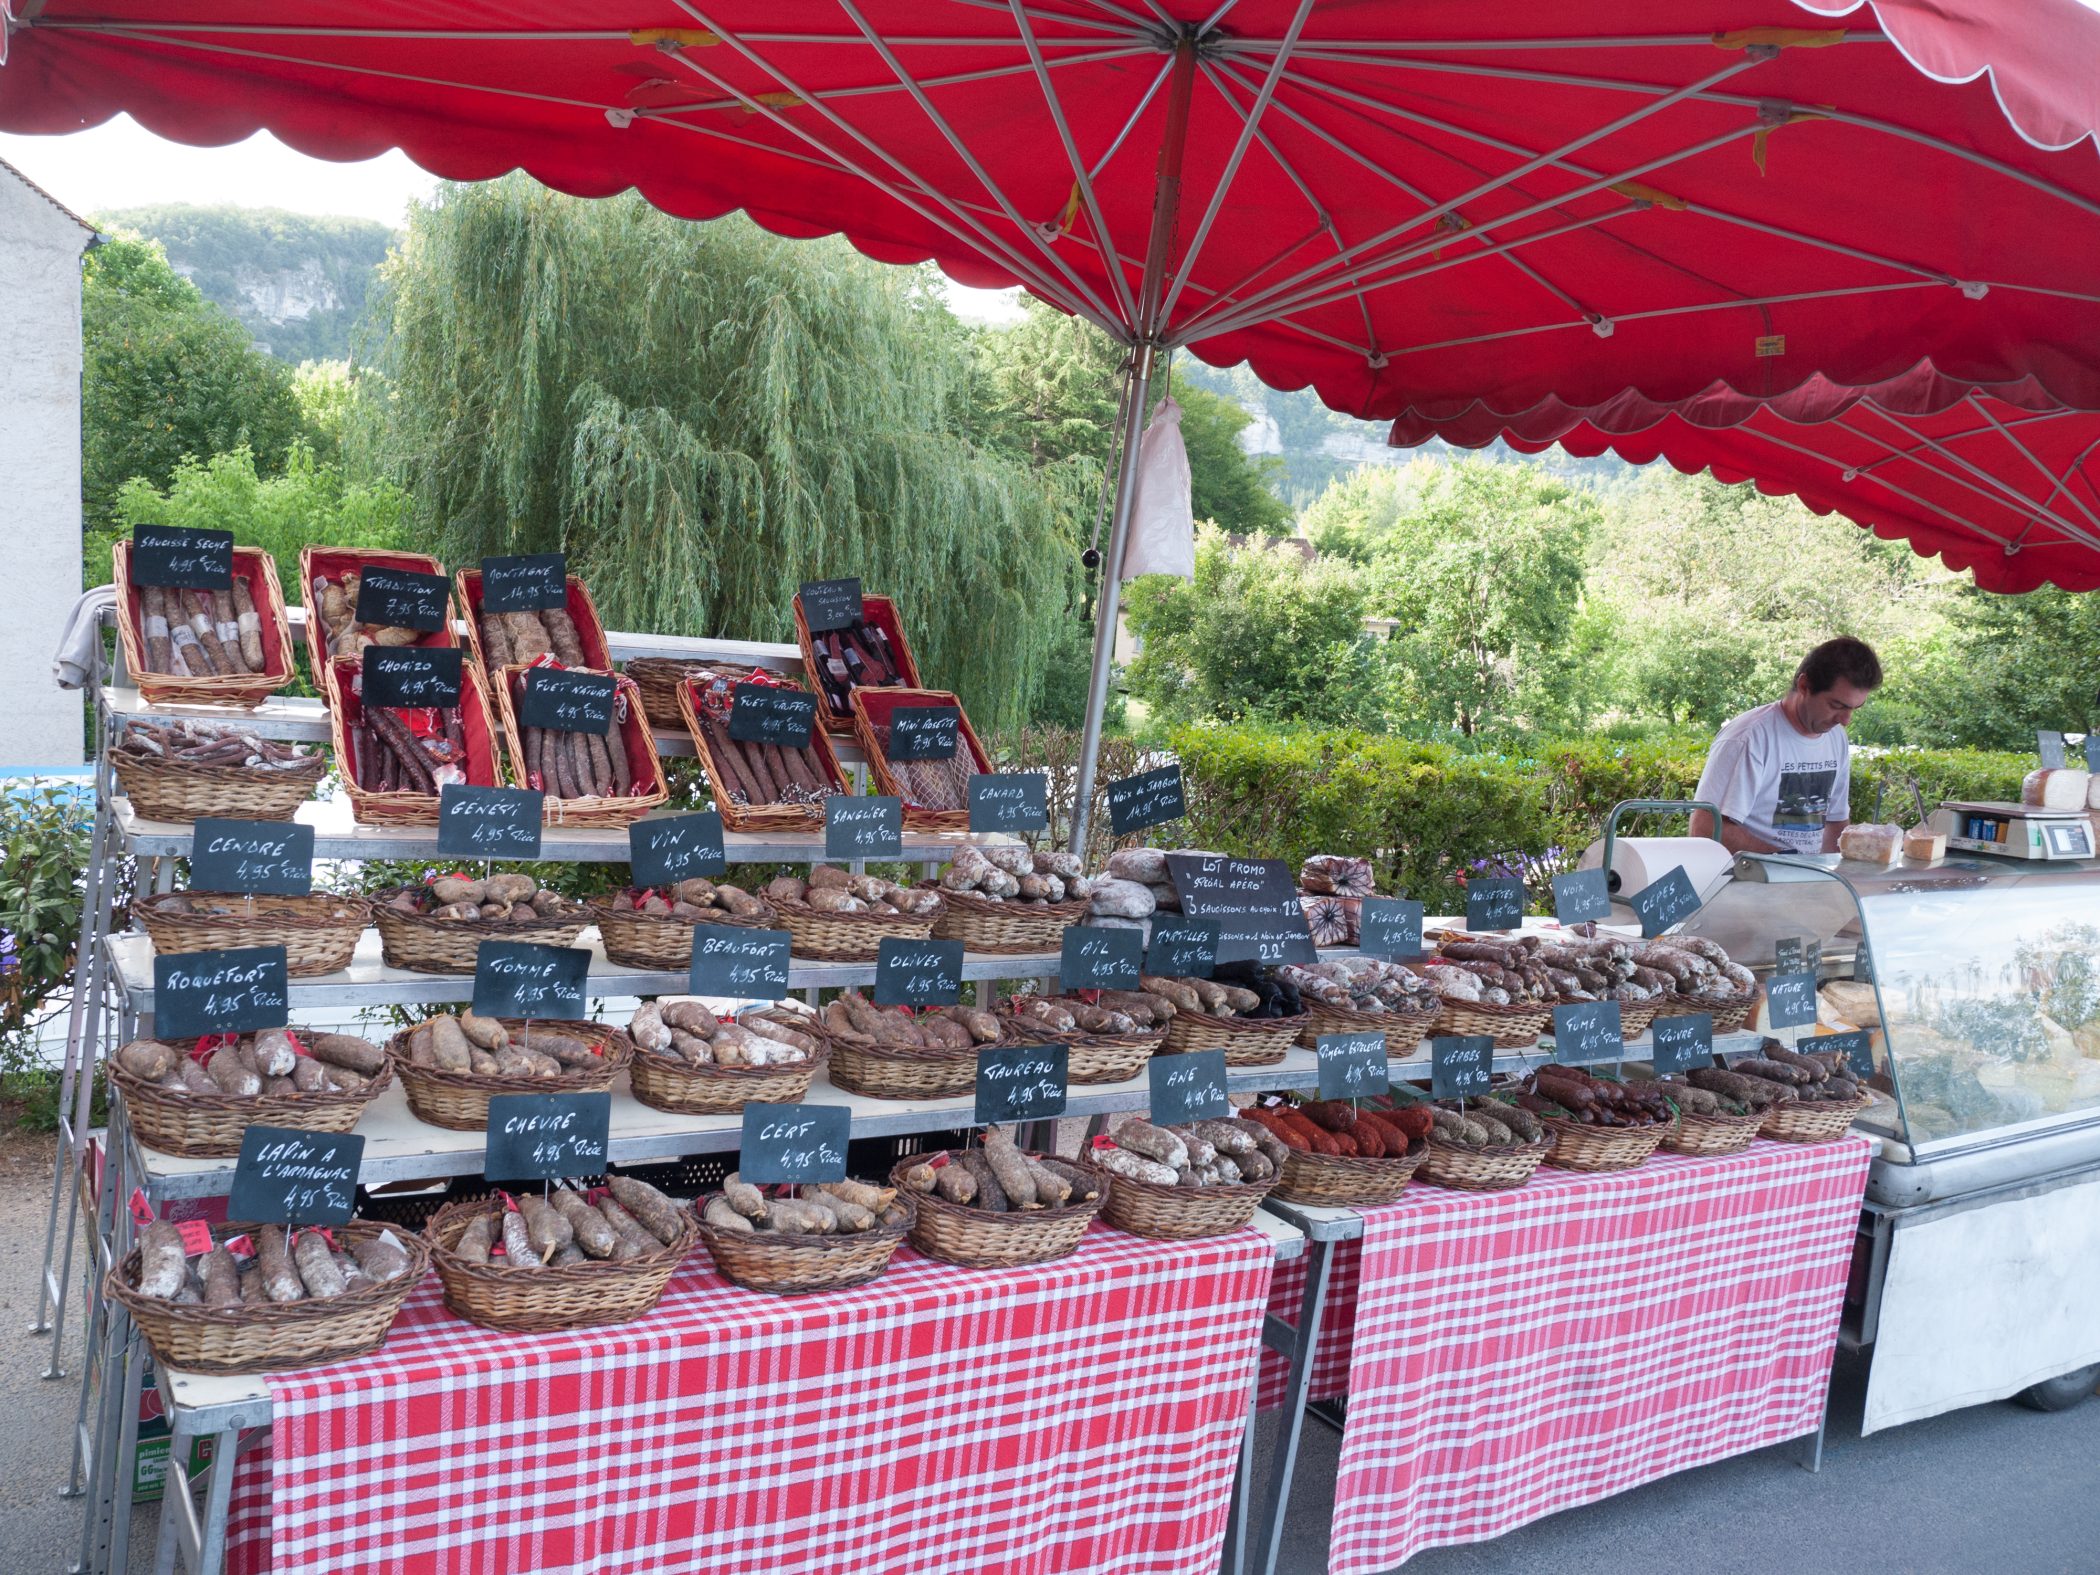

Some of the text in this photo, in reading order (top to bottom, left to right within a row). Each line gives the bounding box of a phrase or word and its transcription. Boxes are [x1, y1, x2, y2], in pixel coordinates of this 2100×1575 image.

[140, 536, 190, 548] SAUCISSE
[490, 566, 554, 584] MONTAGNE
[366, 577, 436, 595] TRADITION
[378, 659, 432, 673] CHORIZO
[536, 679, 611, 698] FUET NATURE
[741, 695, 812, 713] FUET TRUFFES
[922, 717, 956, 730] ROSETTE
[1797, 762, 1823, 770] PETITS
[979, 788, 1024, 800] CANARD
[1113, 791, 1132, 803] NOIX
[1147, 777, 1179, 792] JAMBON
[832, 805, 888, 824] SANGLIER
[651, 830, 686, 849] VIN
[1203, 858, 1265, 876] LOT PROMO
[1471, 889, 1514, 901] NOISETTES
[1562, 882, 1584, 896] NOIX
[1186, 895, 1197, 914] 3
[1200, 904, 1246, 914] SAUCISSONS
[1370, 911, 1406, 924] FIGUES
[702, 938, 785, 956] BEAUFORT
[1080, 940, 1109, 956] AIL
[490, 957, 556, 978] TOMME
[890, 952, 942, 968] OLIVES
[167, 962, 277, 991] ROQUEFORT
[1771, 981, 1804, 995] NATURE
[984, 1061, 1054, 1080] TAUREAU
[1167, 1067, 1198, 1086] ANE
[505, 1112, 576, 1134] CHEVRE
[760, 1121, 816, 1140] CERF
[257, 1141, 336, 1163] LAPIN A
